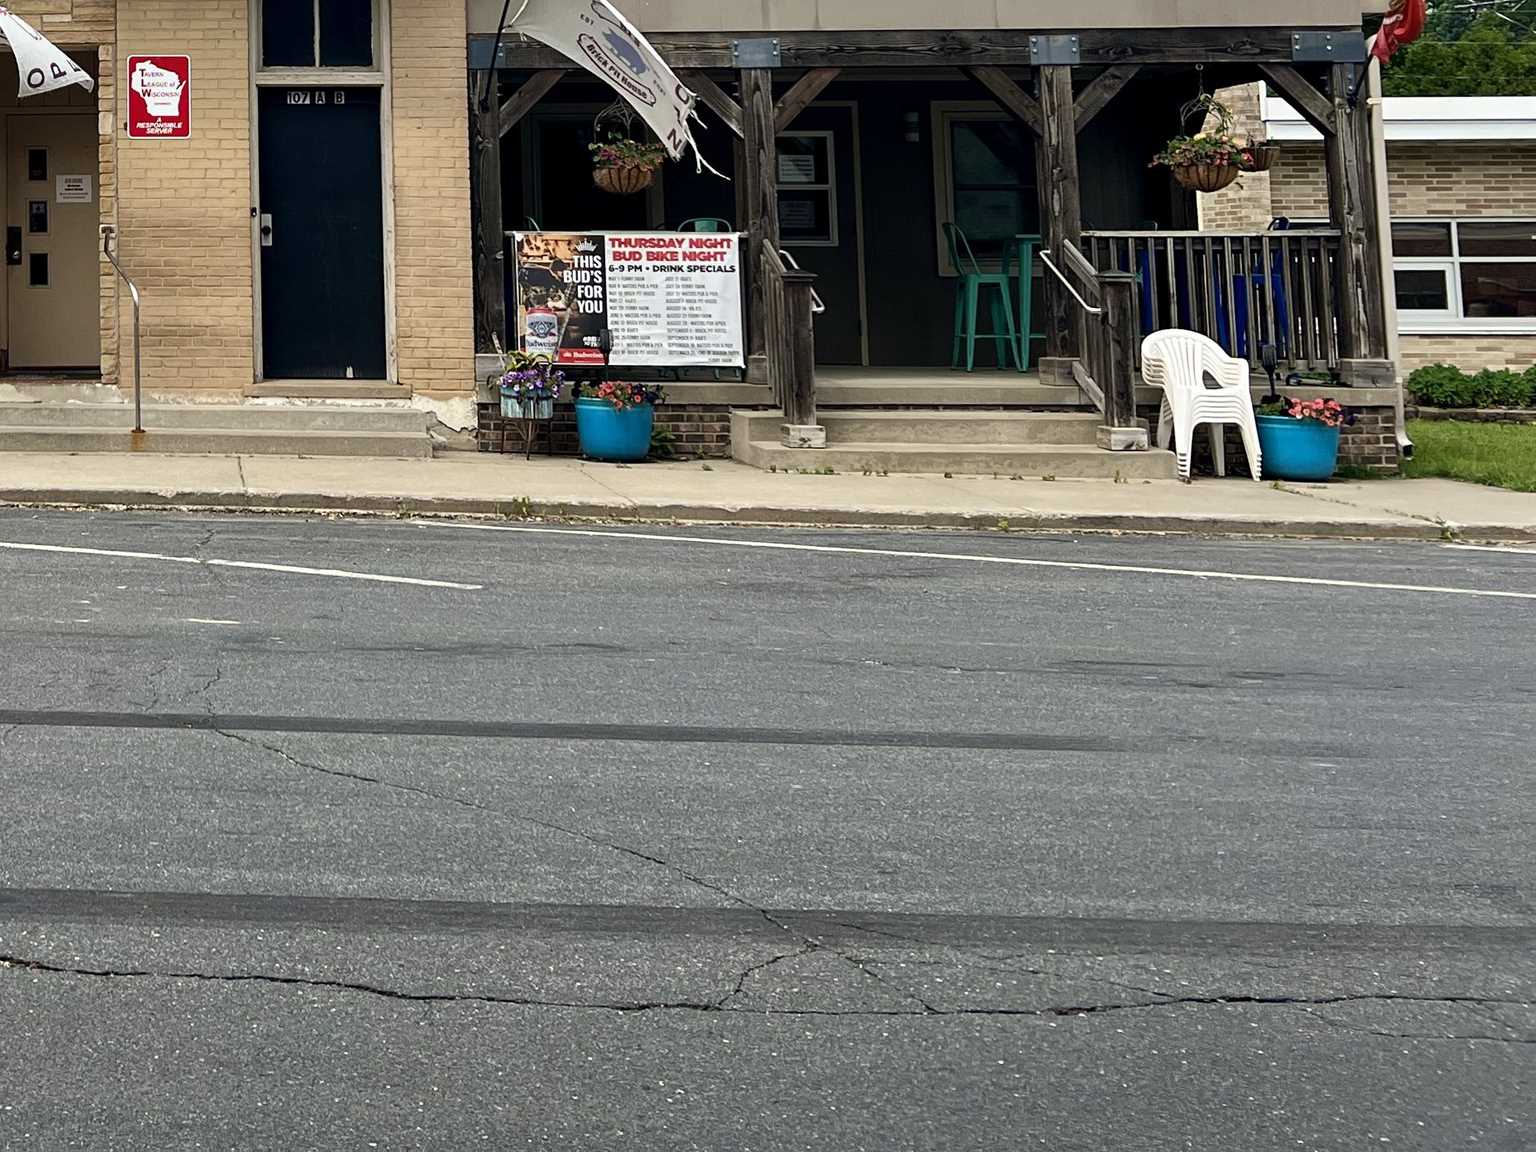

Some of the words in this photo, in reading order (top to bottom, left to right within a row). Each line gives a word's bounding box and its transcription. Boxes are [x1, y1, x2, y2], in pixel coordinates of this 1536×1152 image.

[587, 44, 608, 67] Brick
[621, 76, 648, 99] House
[287, 92, 310, 104] 107
[316, 92, 325, 104] A
[335, 92, 344, 104] B
[608, 238, 688, 249] THURSDAY
[689, 238, 733, 249] NIGHT
[573, 255, 602, 268] THIS
[612, 251, 643, 262] BUD
[646, 251, 678, 262] BIKE
[682, 251, 727, 262] NIGHT
[608, 265, 625, 273] 6-9
[627, 265, 643, 273] PM
[653, 265, 684, 273] DRINK
[687, 265, 736, 273] SPECIALS
[564, 270, 602, 283] BUD'S
[577, 285, 603, 298] FOR
[577, 300, 603, 314] YOU
